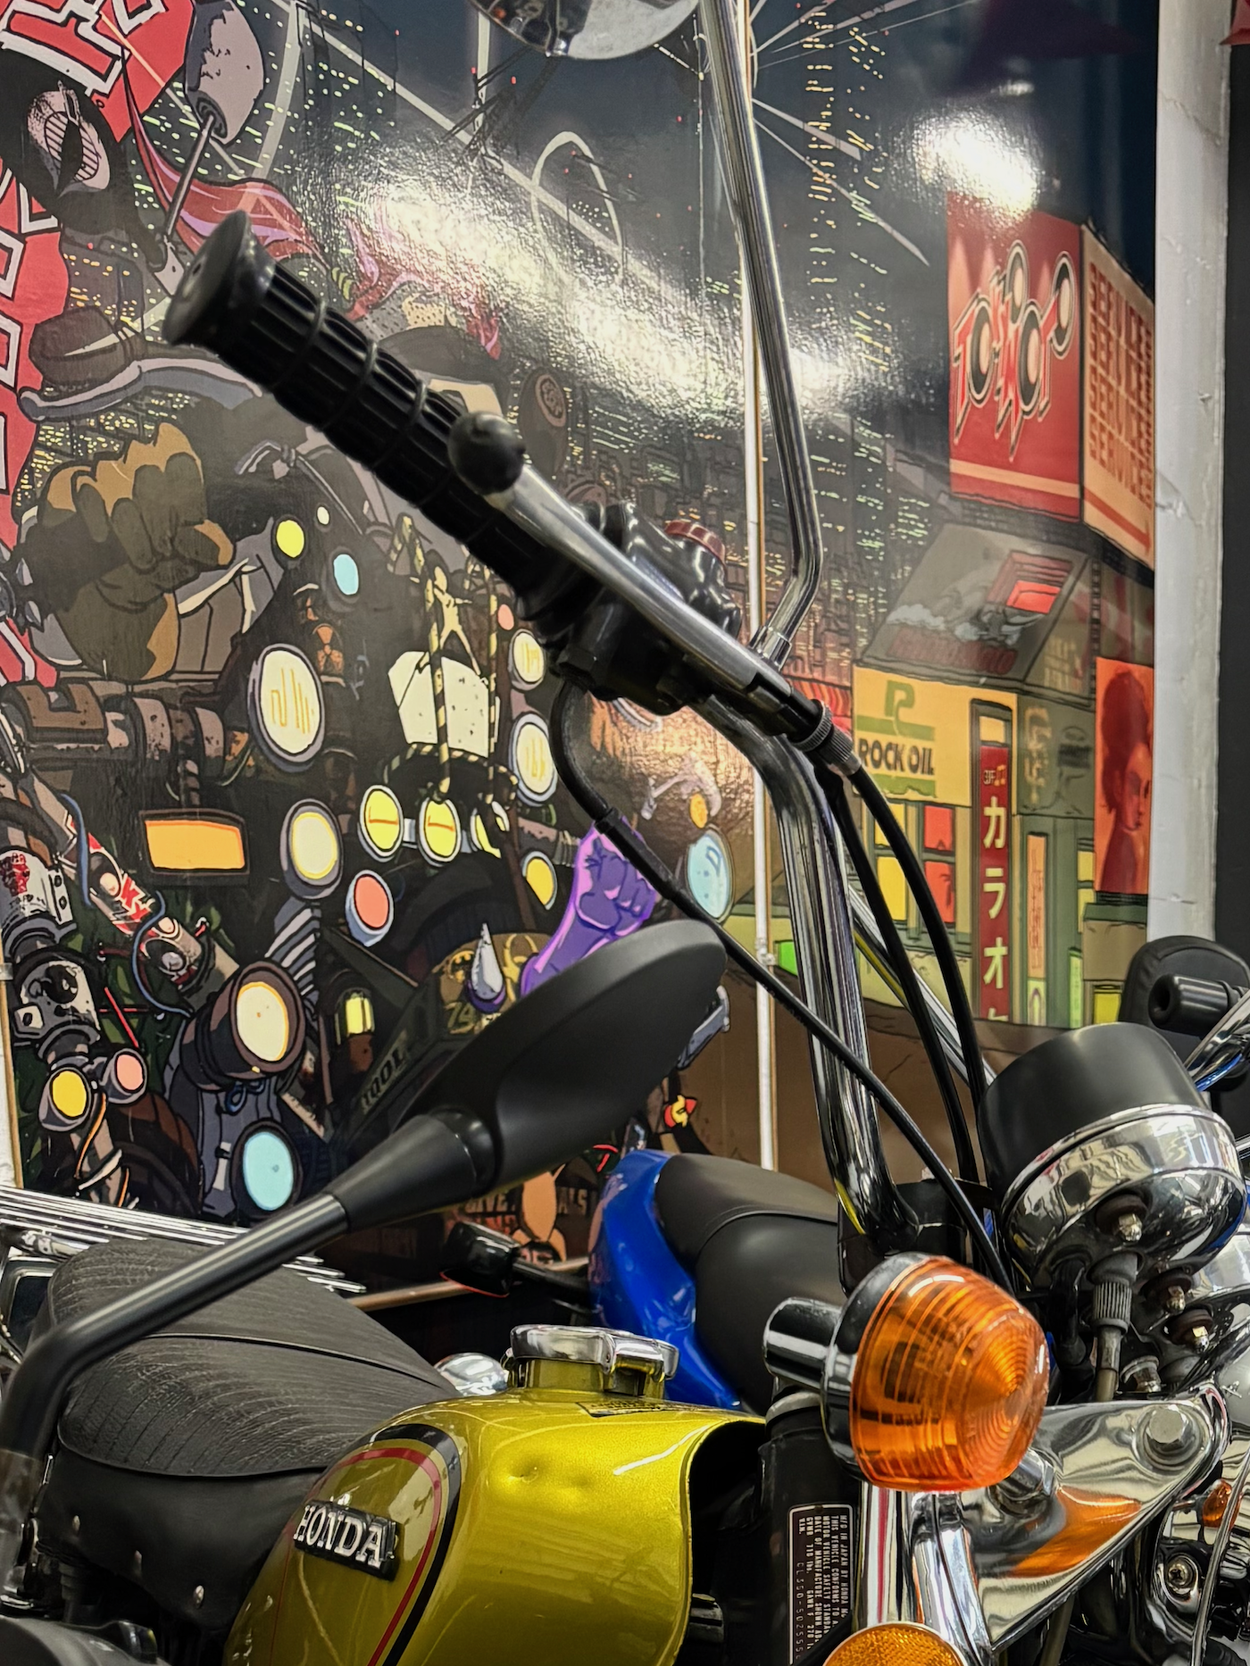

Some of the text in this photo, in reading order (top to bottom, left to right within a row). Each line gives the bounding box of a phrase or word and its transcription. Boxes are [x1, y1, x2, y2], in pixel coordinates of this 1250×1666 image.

[858, 738, 935, 776] ROCK OIL
[983, 796, 1008, 1022] カラオ
[814, 1515, 823, 1533] DATE
[823, 1515, 831, 1538] MOTOR
[831, 1515, 840, 1531] THIS
[293, 1505, 381, 1569] HONDA
[831, 1535, 840, 1563] VEHICLE
[823, 1541, 831, 1570] VEHICLE
[840, 1544, 849, 1566] JAPAN
[814, 1549, 823, 1599] MANUFACTURE
[823, 1574, 831, 1600] SAFETY
[831, 1567, 840, 1603] CONFORMS
[840, 1582, 849, 1605] HONDA
[814, 1602, 823, 1627] SHOWN
